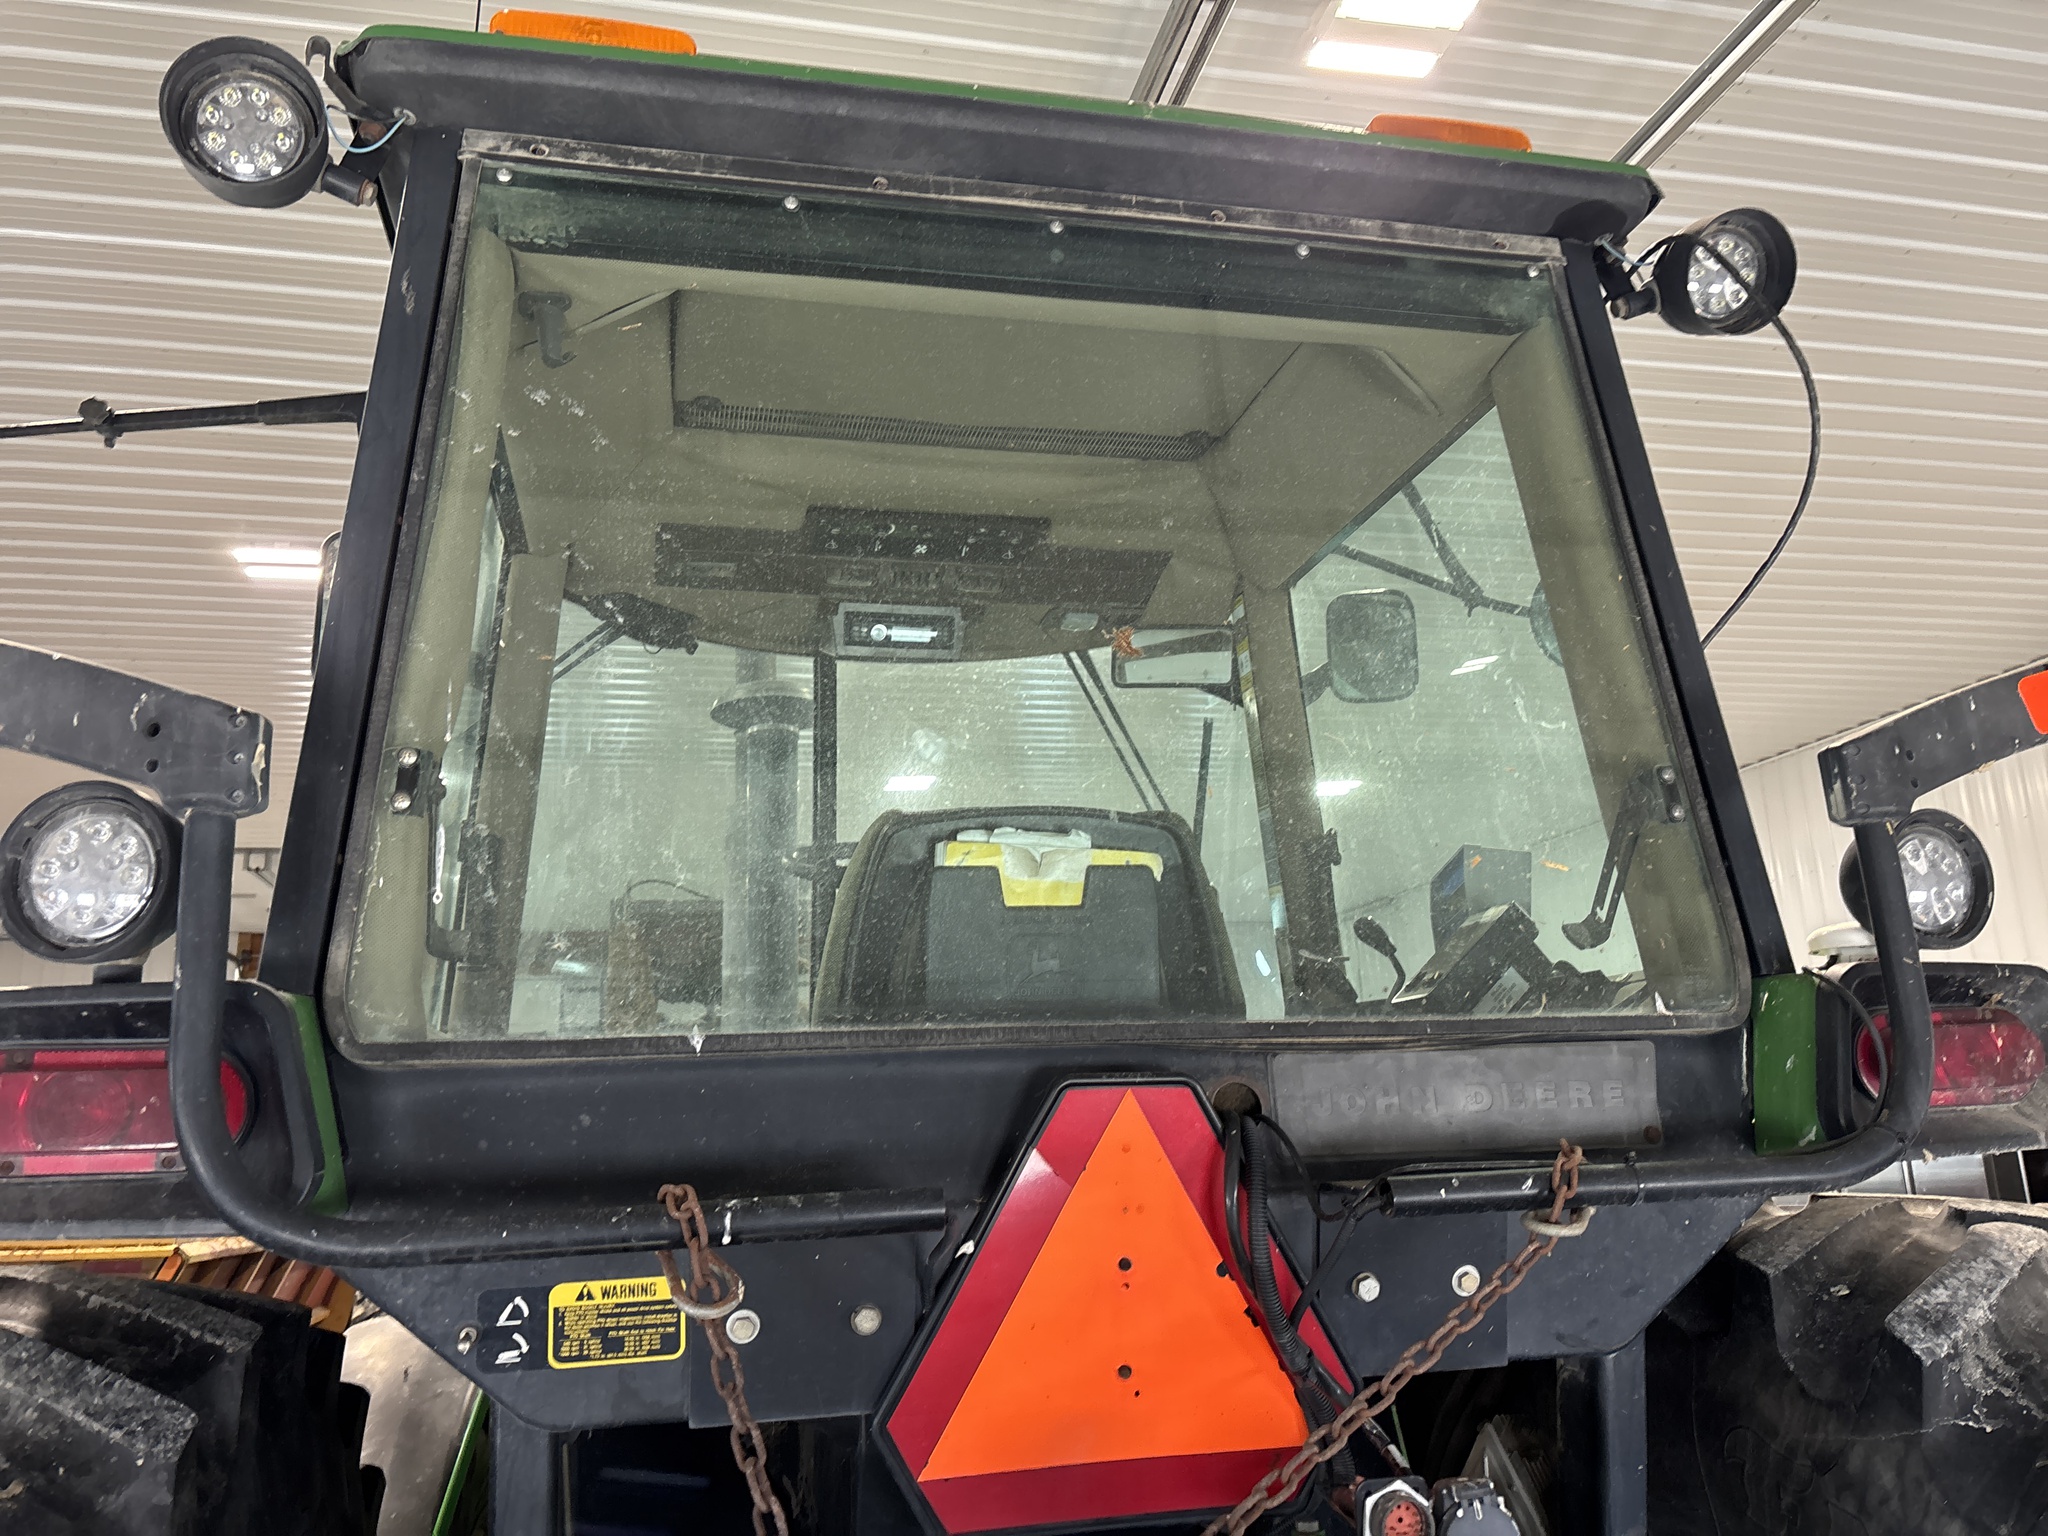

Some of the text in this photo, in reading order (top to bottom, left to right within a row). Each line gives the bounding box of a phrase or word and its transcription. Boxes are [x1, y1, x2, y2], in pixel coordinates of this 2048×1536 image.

[1311, 1079, 1626, 1117] JOHN DEERE
[600, 1282, 657, 1300] WARNING
